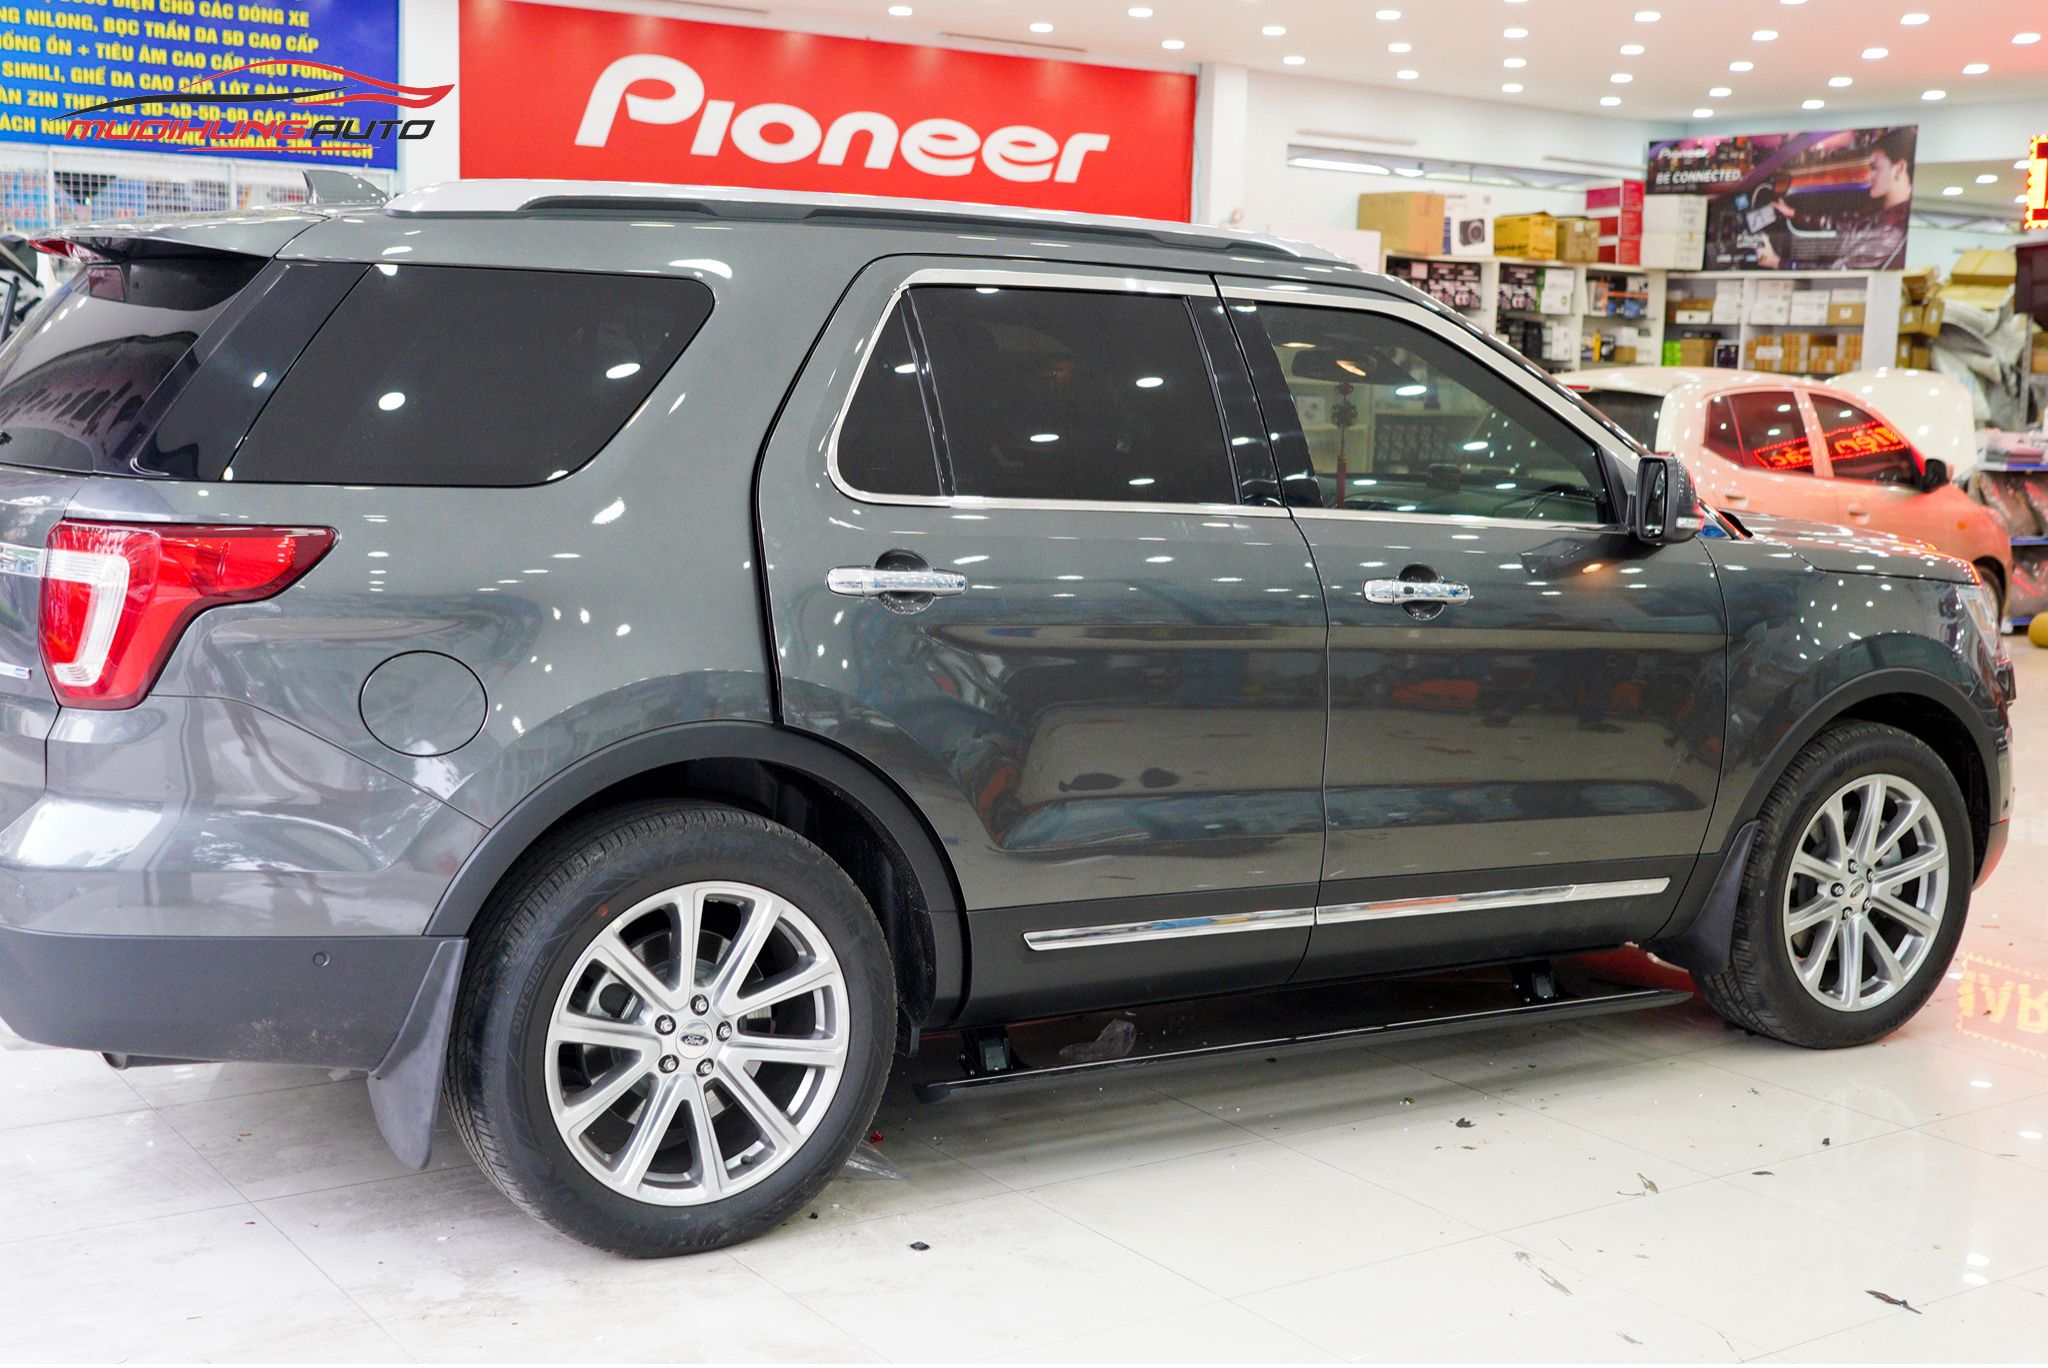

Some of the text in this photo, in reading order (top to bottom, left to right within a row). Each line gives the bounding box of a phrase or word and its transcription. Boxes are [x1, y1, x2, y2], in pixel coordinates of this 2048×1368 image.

[288, 10, 310, 28] XE
[25, 9, 99, 33] NILONG,
[103, 17, 140, 38] BỌC
[194, 26, 219, 45] DA
[222, 29, 245, 47] 5D
[248, 32, 282, 50] CAO
[172, 50, 207, 69] CAO
[2, 61, 65, 82] SIMILI,
[110, 70, 135, 88] DA
[139, 74, 174, 92] CAO
[27, 90, 58, 109] ZIN
[573, 53, 1111, 184] Pioneer
[1656, 171, 1671, 184] BE
[683, 1034, 706, 1046] Ford
